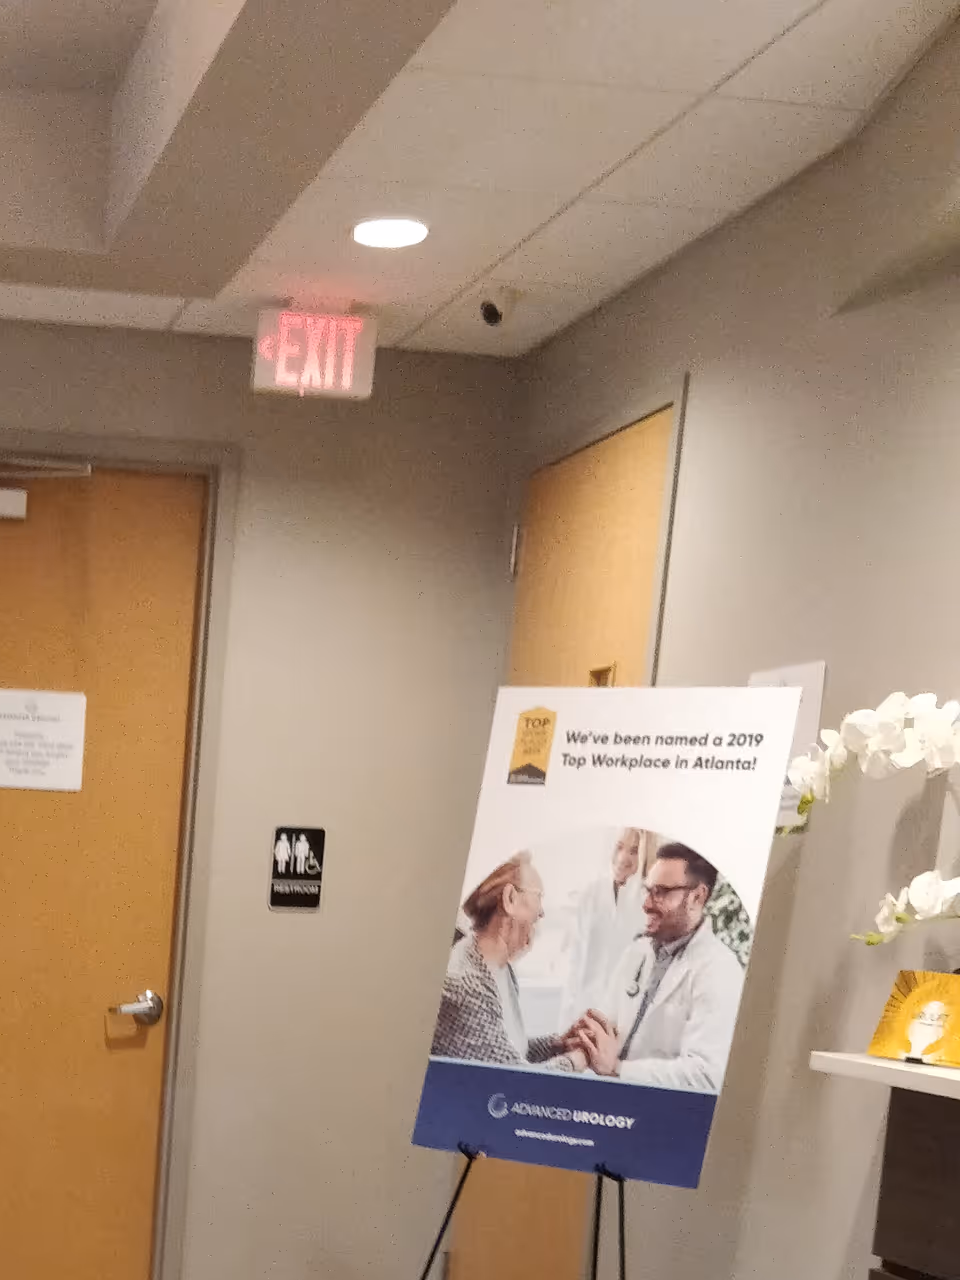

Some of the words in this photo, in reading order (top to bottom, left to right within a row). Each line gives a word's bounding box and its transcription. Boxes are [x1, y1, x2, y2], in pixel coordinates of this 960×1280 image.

[276, 311, 363, 391] EXIT
[524, 716, 551, 729] TOP
[565, 730, 609, 745] We've
[613, 732, 651, 746] been
[654, 733, 709, 747] named
[712, 736, 723, 747] a
[727, 732, 765, 748] 2019
[561, 753, 587, 770] Top
[591, 753, 671, 772] Workplace
[675, 754, 689, 769] in
[692, 755, 757, 771] Atlanta!
[510, 1102, 572, 1121] ADVANCED
[572, 1109, 636, 1130] UROLOGY
